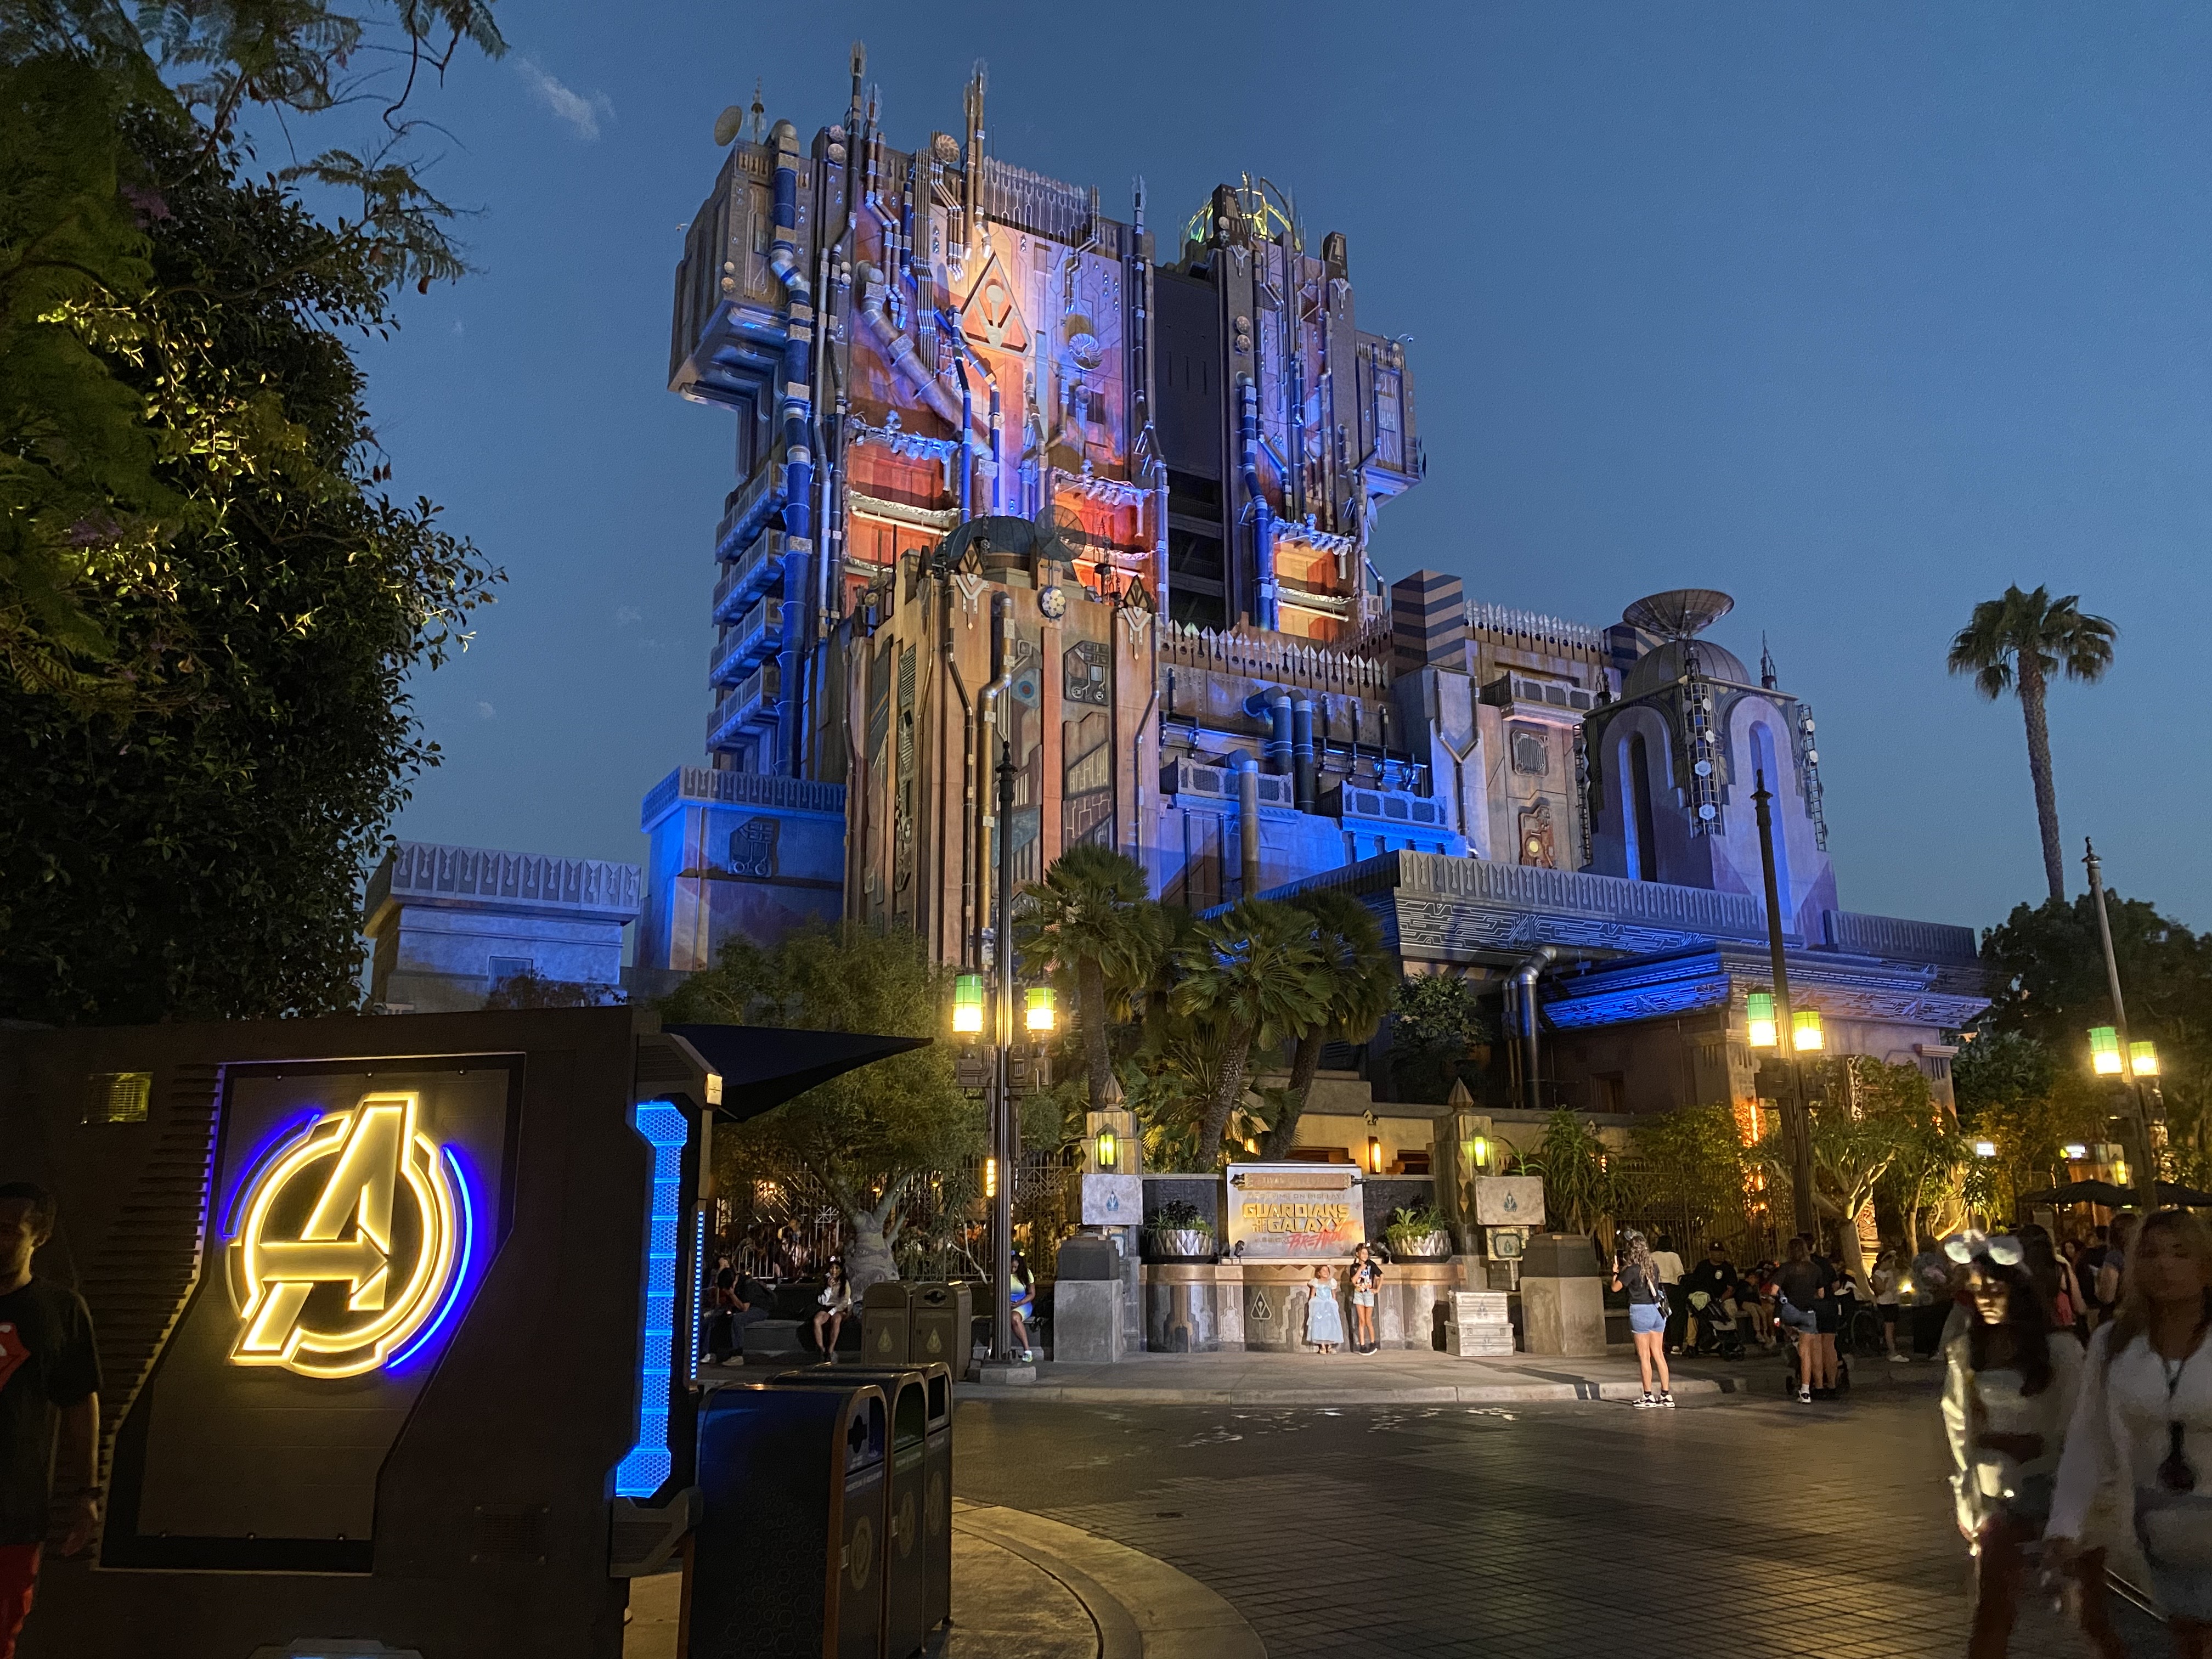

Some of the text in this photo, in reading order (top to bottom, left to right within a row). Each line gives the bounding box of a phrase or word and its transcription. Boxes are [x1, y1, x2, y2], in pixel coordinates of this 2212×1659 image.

[1243, 1203, 1350, 1218] GUARDIANS
[1251, 1218, 1347, 1233] THE GALAXY
